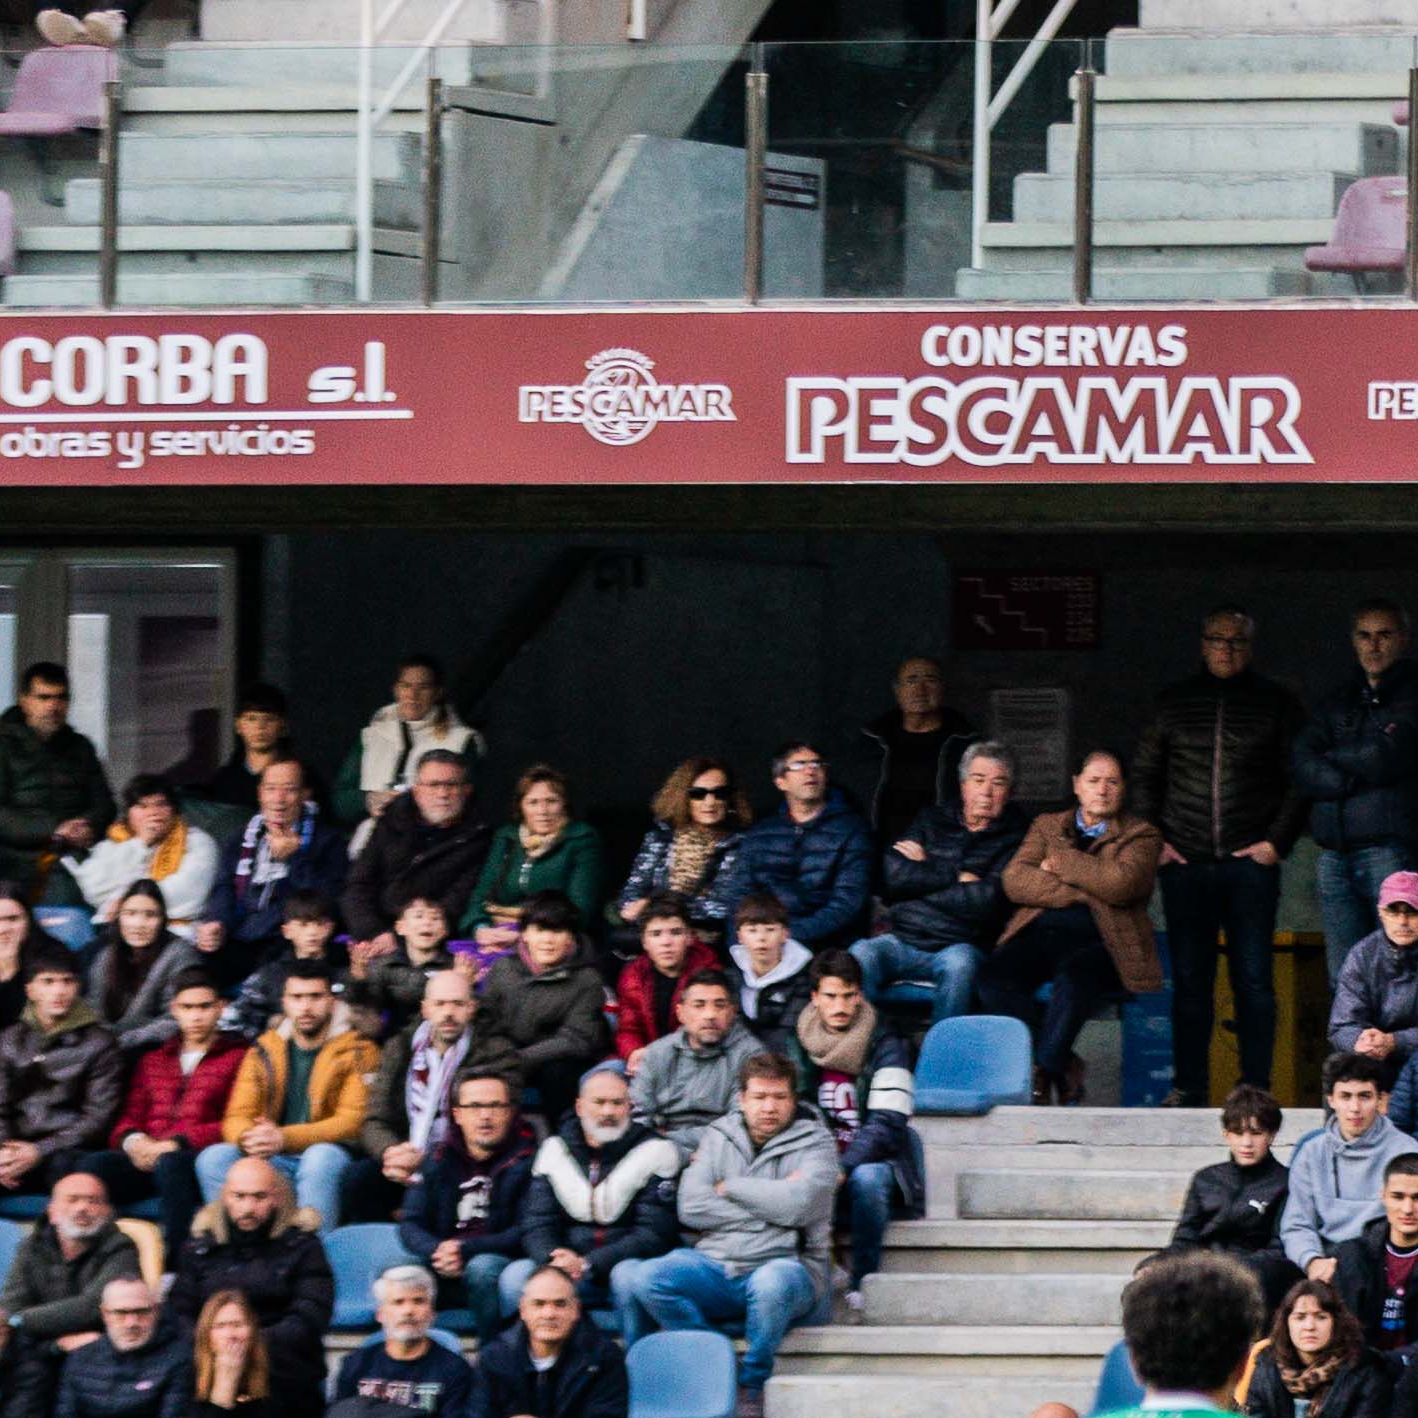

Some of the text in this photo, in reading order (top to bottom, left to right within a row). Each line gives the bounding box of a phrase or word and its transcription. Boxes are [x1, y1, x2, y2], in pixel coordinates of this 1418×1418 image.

[920, 324, 1188, 368] CONSERVAS
[519, 384, 738, 423] PESCAMAR
[785, 375, 1317, 467] PESCAMAR
[116, 429, 145, 469] y
[149, 424, 316, 457] servicios
